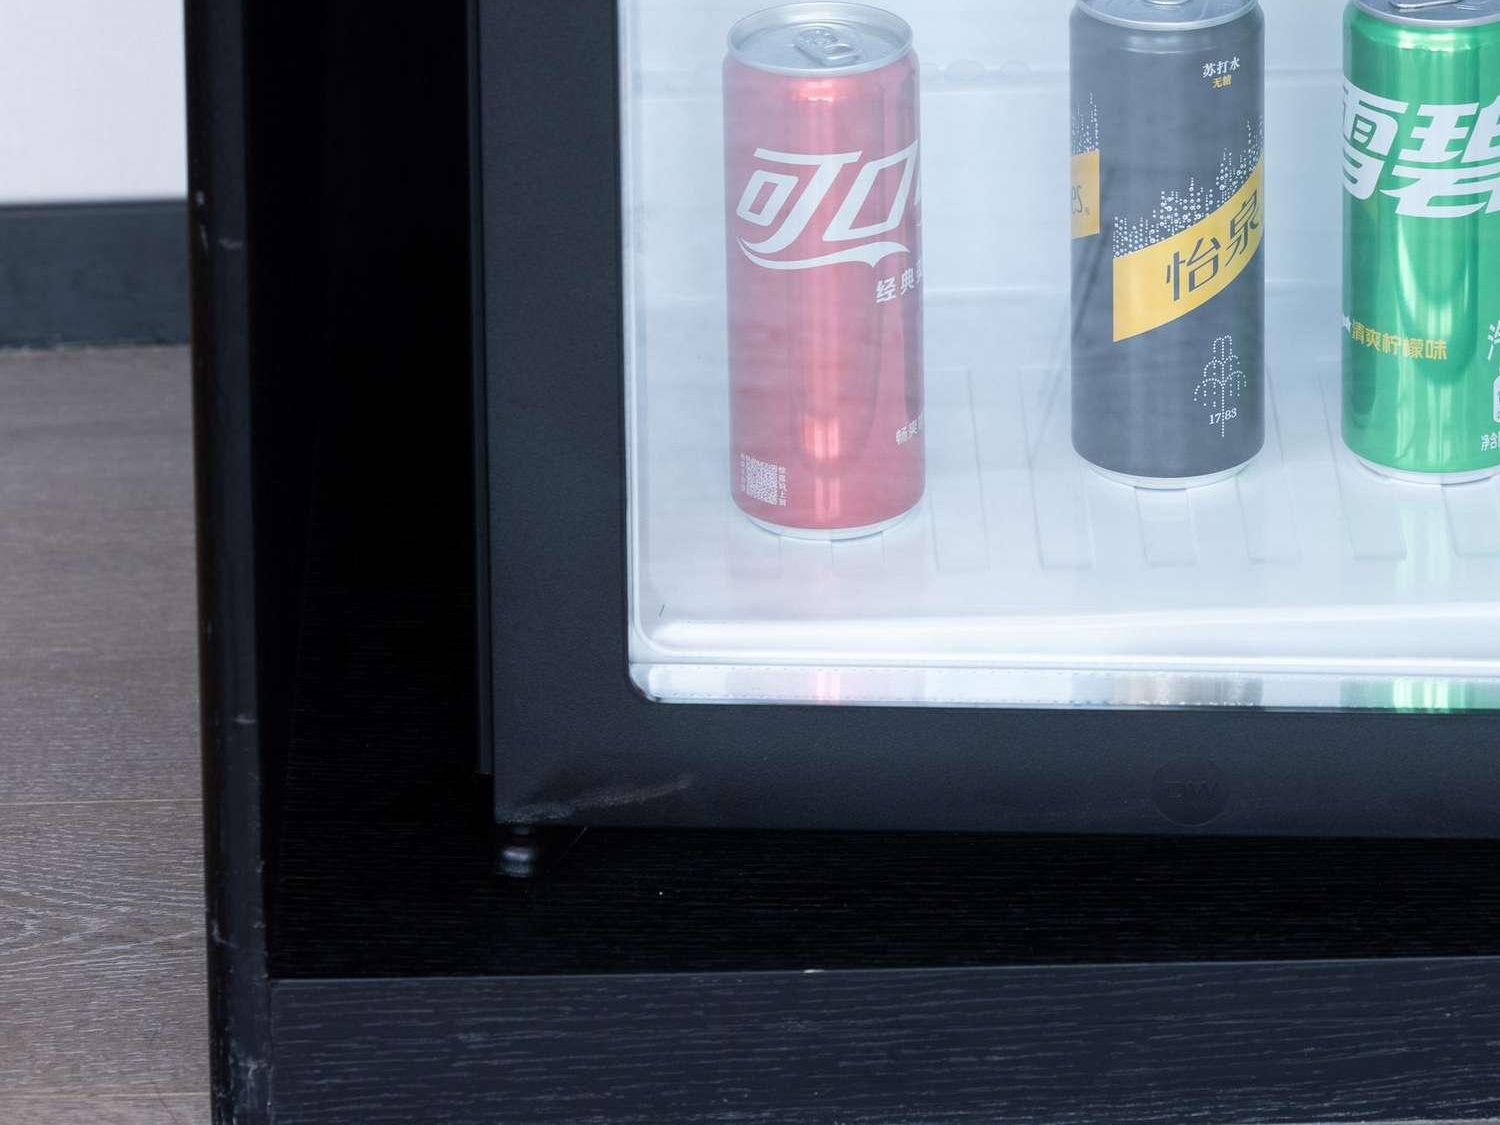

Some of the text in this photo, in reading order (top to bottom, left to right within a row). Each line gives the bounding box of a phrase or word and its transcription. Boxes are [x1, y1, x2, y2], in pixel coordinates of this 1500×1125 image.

[1202, 56, 1241, 79] 苏打水
[735, 138, 921, 256] 可口
[1166, 186, 1260, 302] 怡泉
[1208, 407, 1238, 426] 1783
